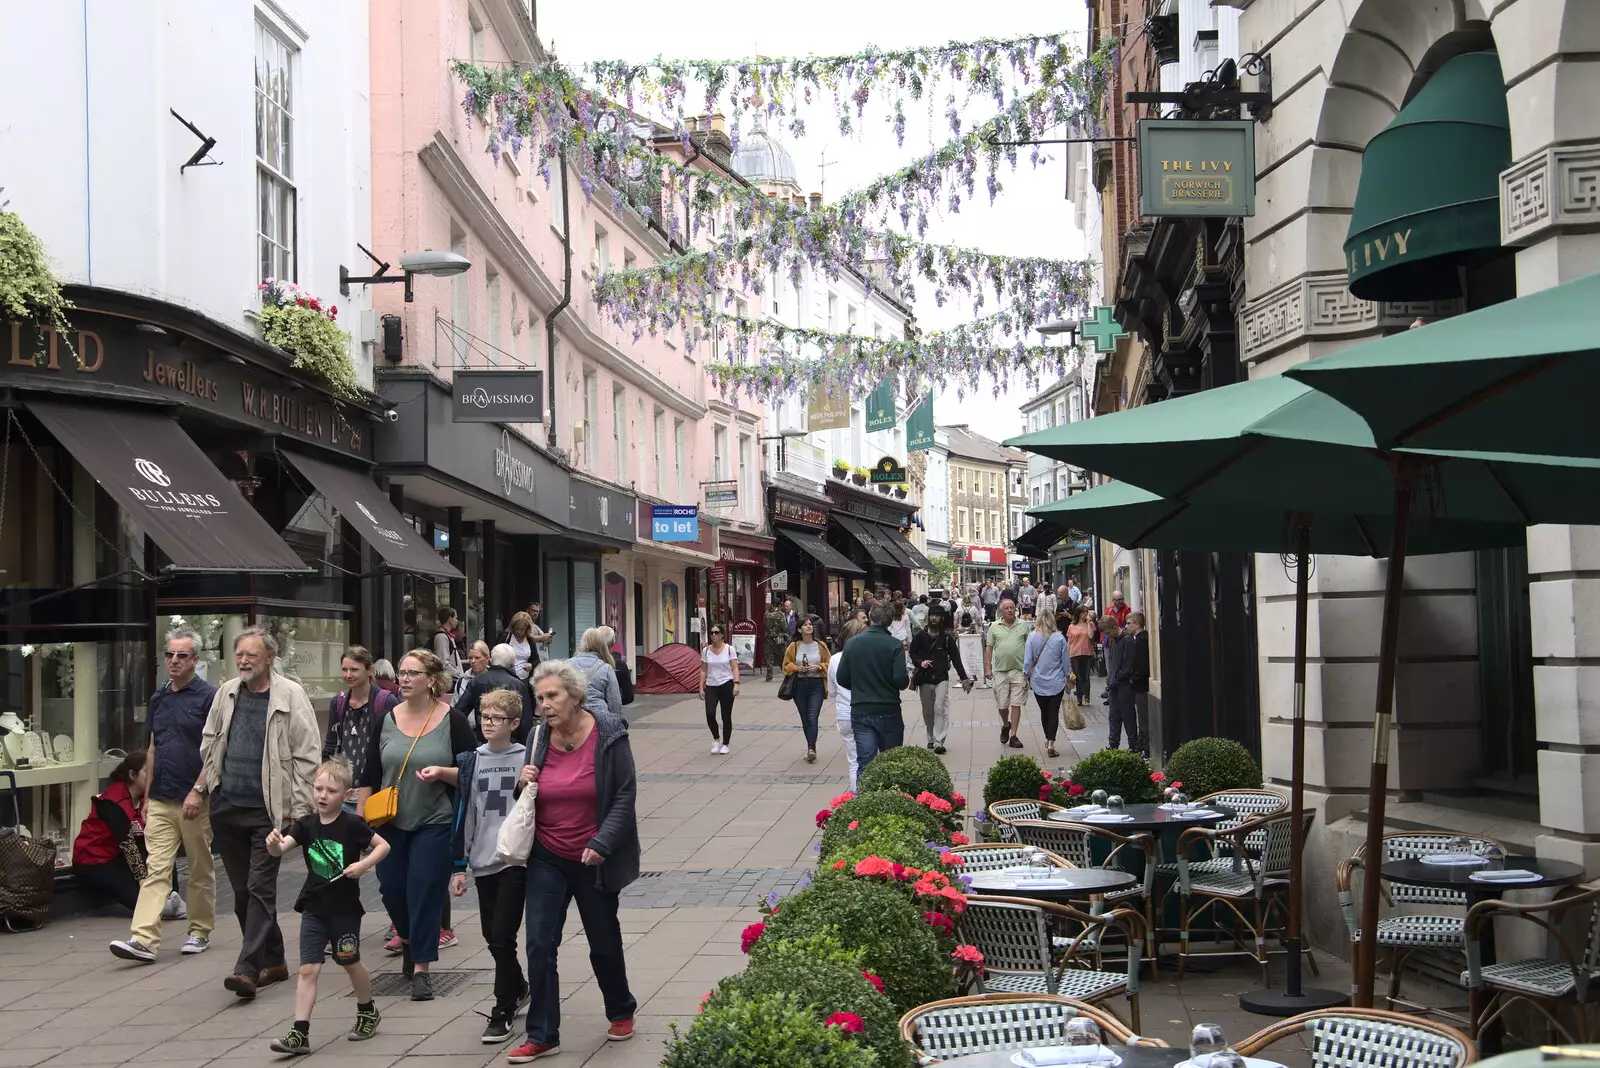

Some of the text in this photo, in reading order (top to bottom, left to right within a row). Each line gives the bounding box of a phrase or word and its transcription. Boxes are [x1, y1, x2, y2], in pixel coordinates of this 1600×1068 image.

[1161, 160, 1233, 171] THE IVY
[1174, 181, 1220, 189] NORWICH
[1172, 189, 1223, 198] BRASSERIE
[1364, 228, 1412, 267] IVY
[8, 321, 104, 373] LTD
[143, 348, 219, 402] Jewellers
[462, 387, 534, 408] BRAVISSIMO
[869, 415, 893, 426] ROLEX
[910, 436, 932, 446] ROLEX
[495, 429, 534, 495] BRAVISSIMO
[872, 472, 904, 481] ROLEX
[128, 487, 221, 507] BULLENS
[654, 520, 692, 533] to let
[720, 547, 735, 561] PSON
[478, 766, 516, 776] MINECRAFT
